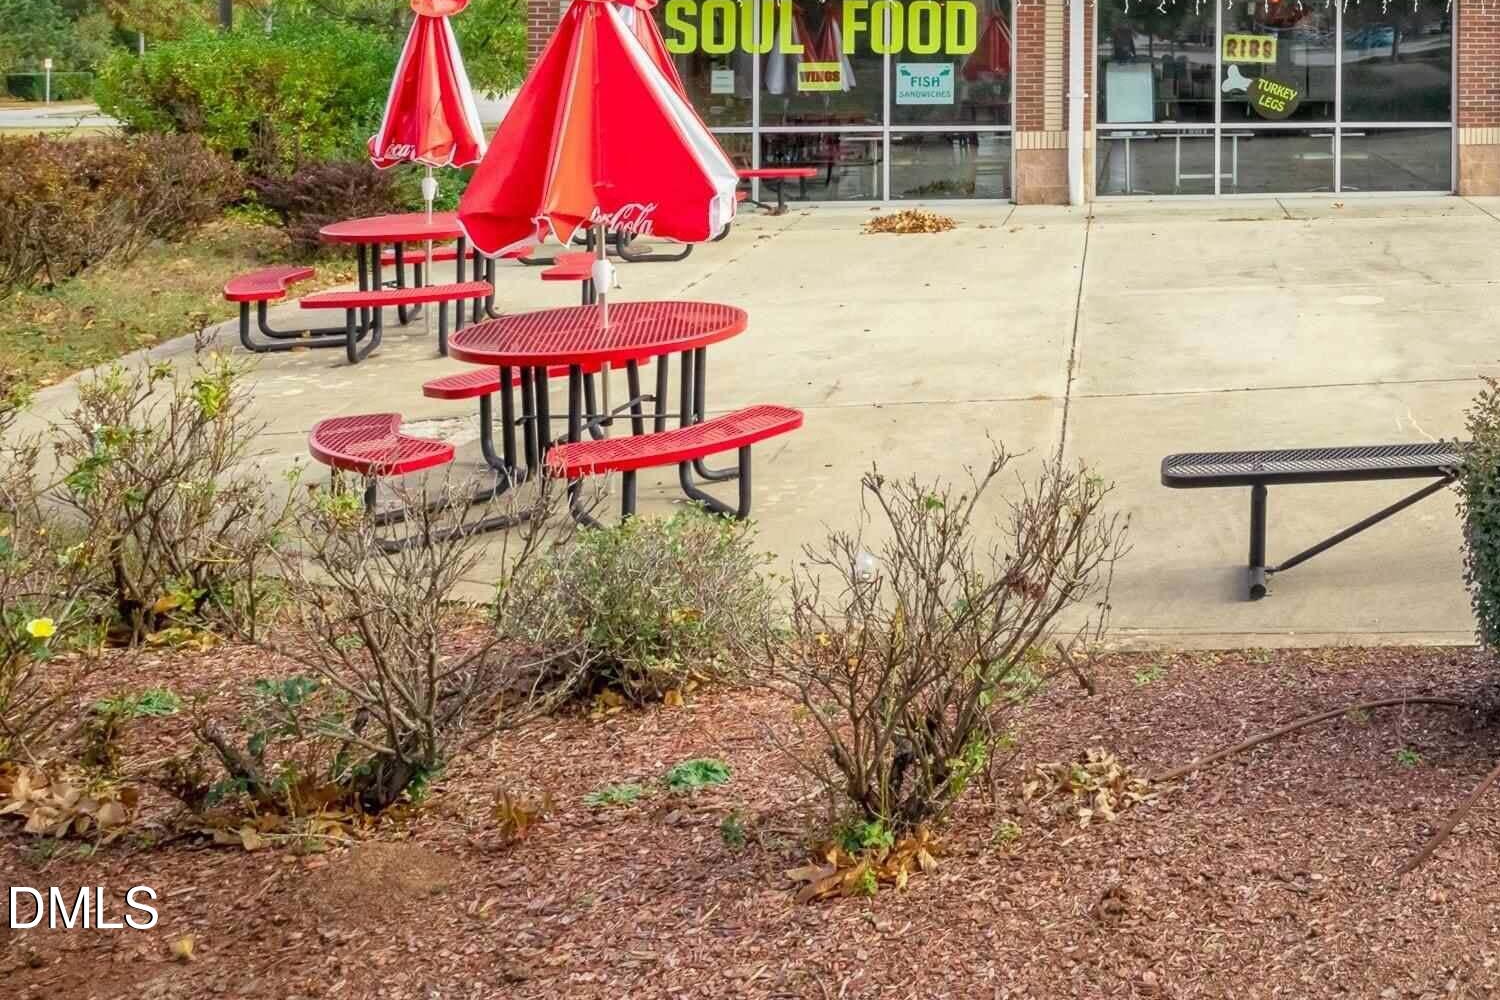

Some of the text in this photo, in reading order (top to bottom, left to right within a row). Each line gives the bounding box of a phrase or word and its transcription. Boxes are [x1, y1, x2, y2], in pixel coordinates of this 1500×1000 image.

[842, 0, 977, 55] FOOD
[1226, 38, 1272, 58] RIBS
[800, 71, 840, 83] WINGS
[910, 76, 940, 87] FISH
[900, 90, 951, 98] SANDWICHES
[1258, 78, 1298, 101] TURKEY
[1258, 94, 1286, 112] LEGS
